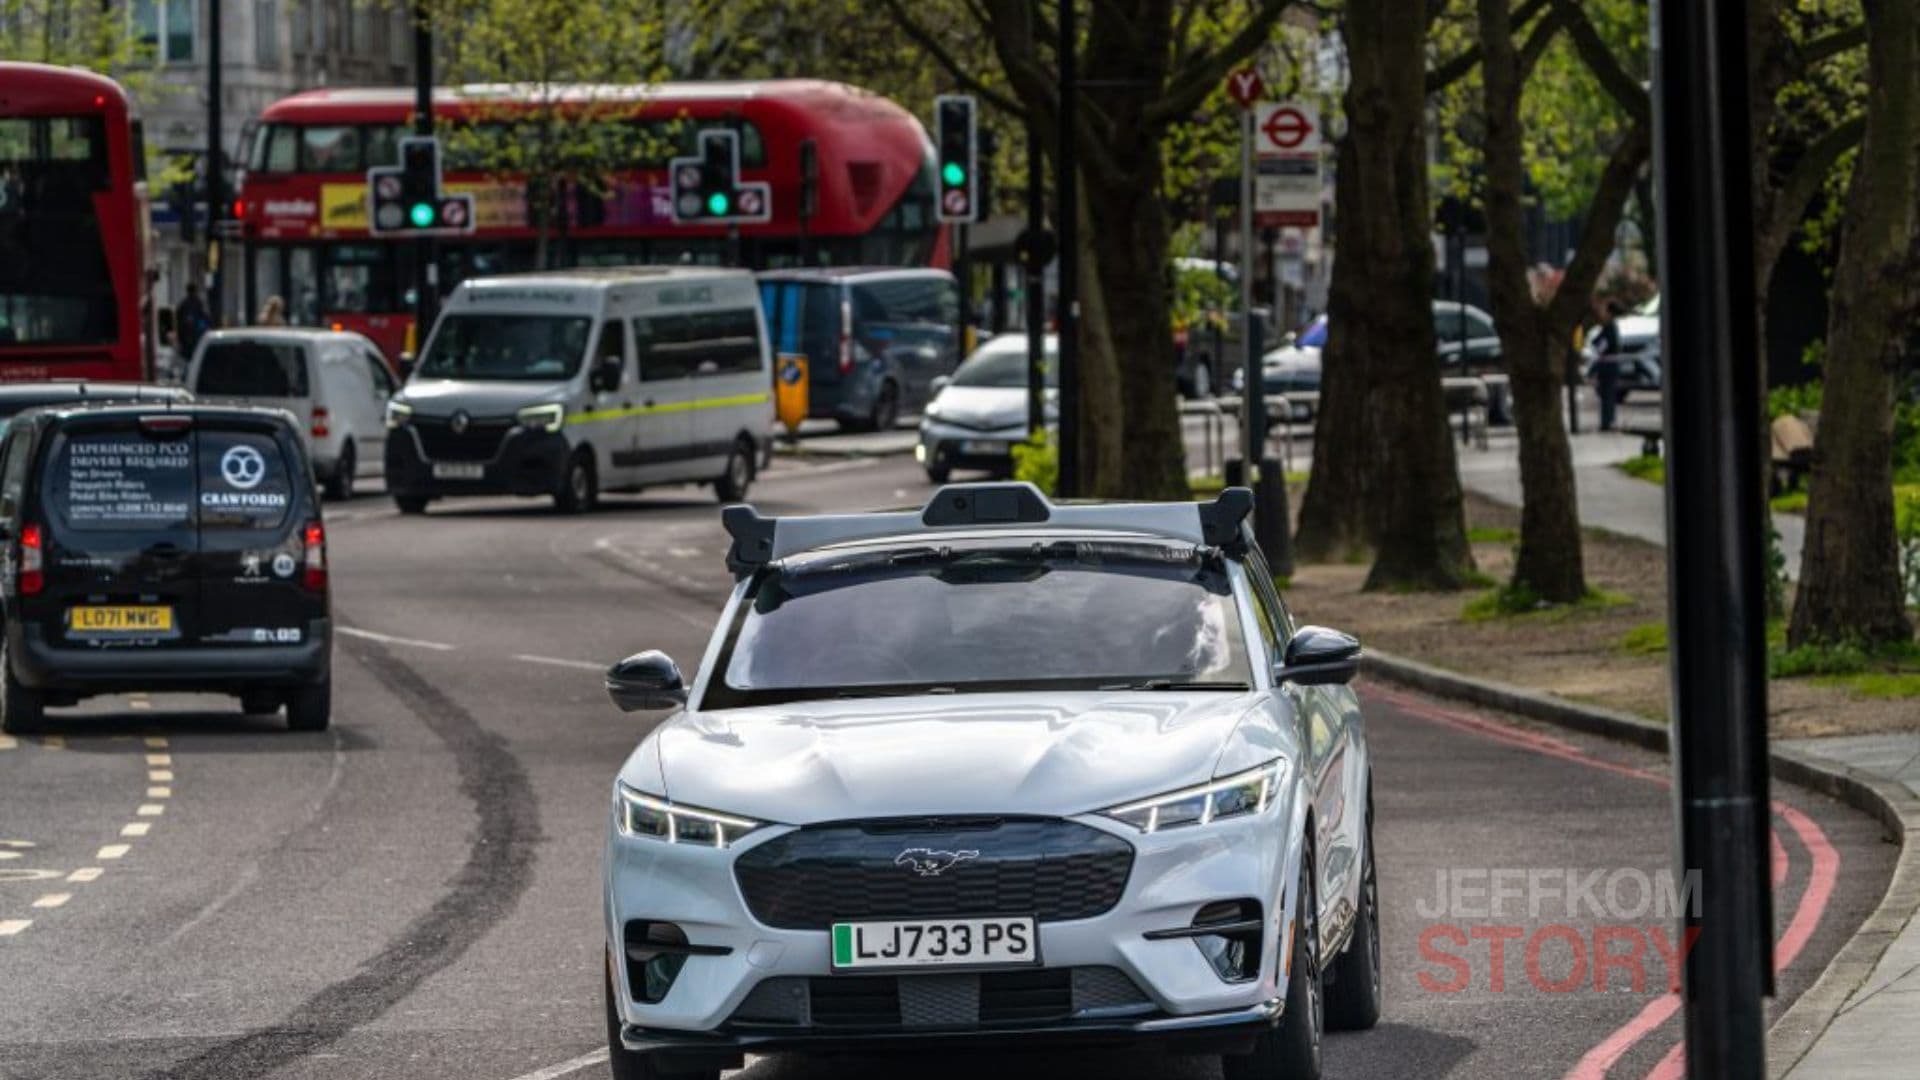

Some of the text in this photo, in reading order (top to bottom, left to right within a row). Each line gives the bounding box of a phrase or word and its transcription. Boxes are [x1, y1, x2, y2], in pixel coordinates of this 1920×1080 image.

[1236, 73, 1256, 98] Y
[71, 443, 189, 455] EXPERIENCED PCO
[71, 456, 189, 468] DRIVERS REQUIRED
[70, 469, 89, 478] Van
[201, 493, 286, 506] CRAWFORDS
[856, 922, 1028, 958] LJ733 PS
